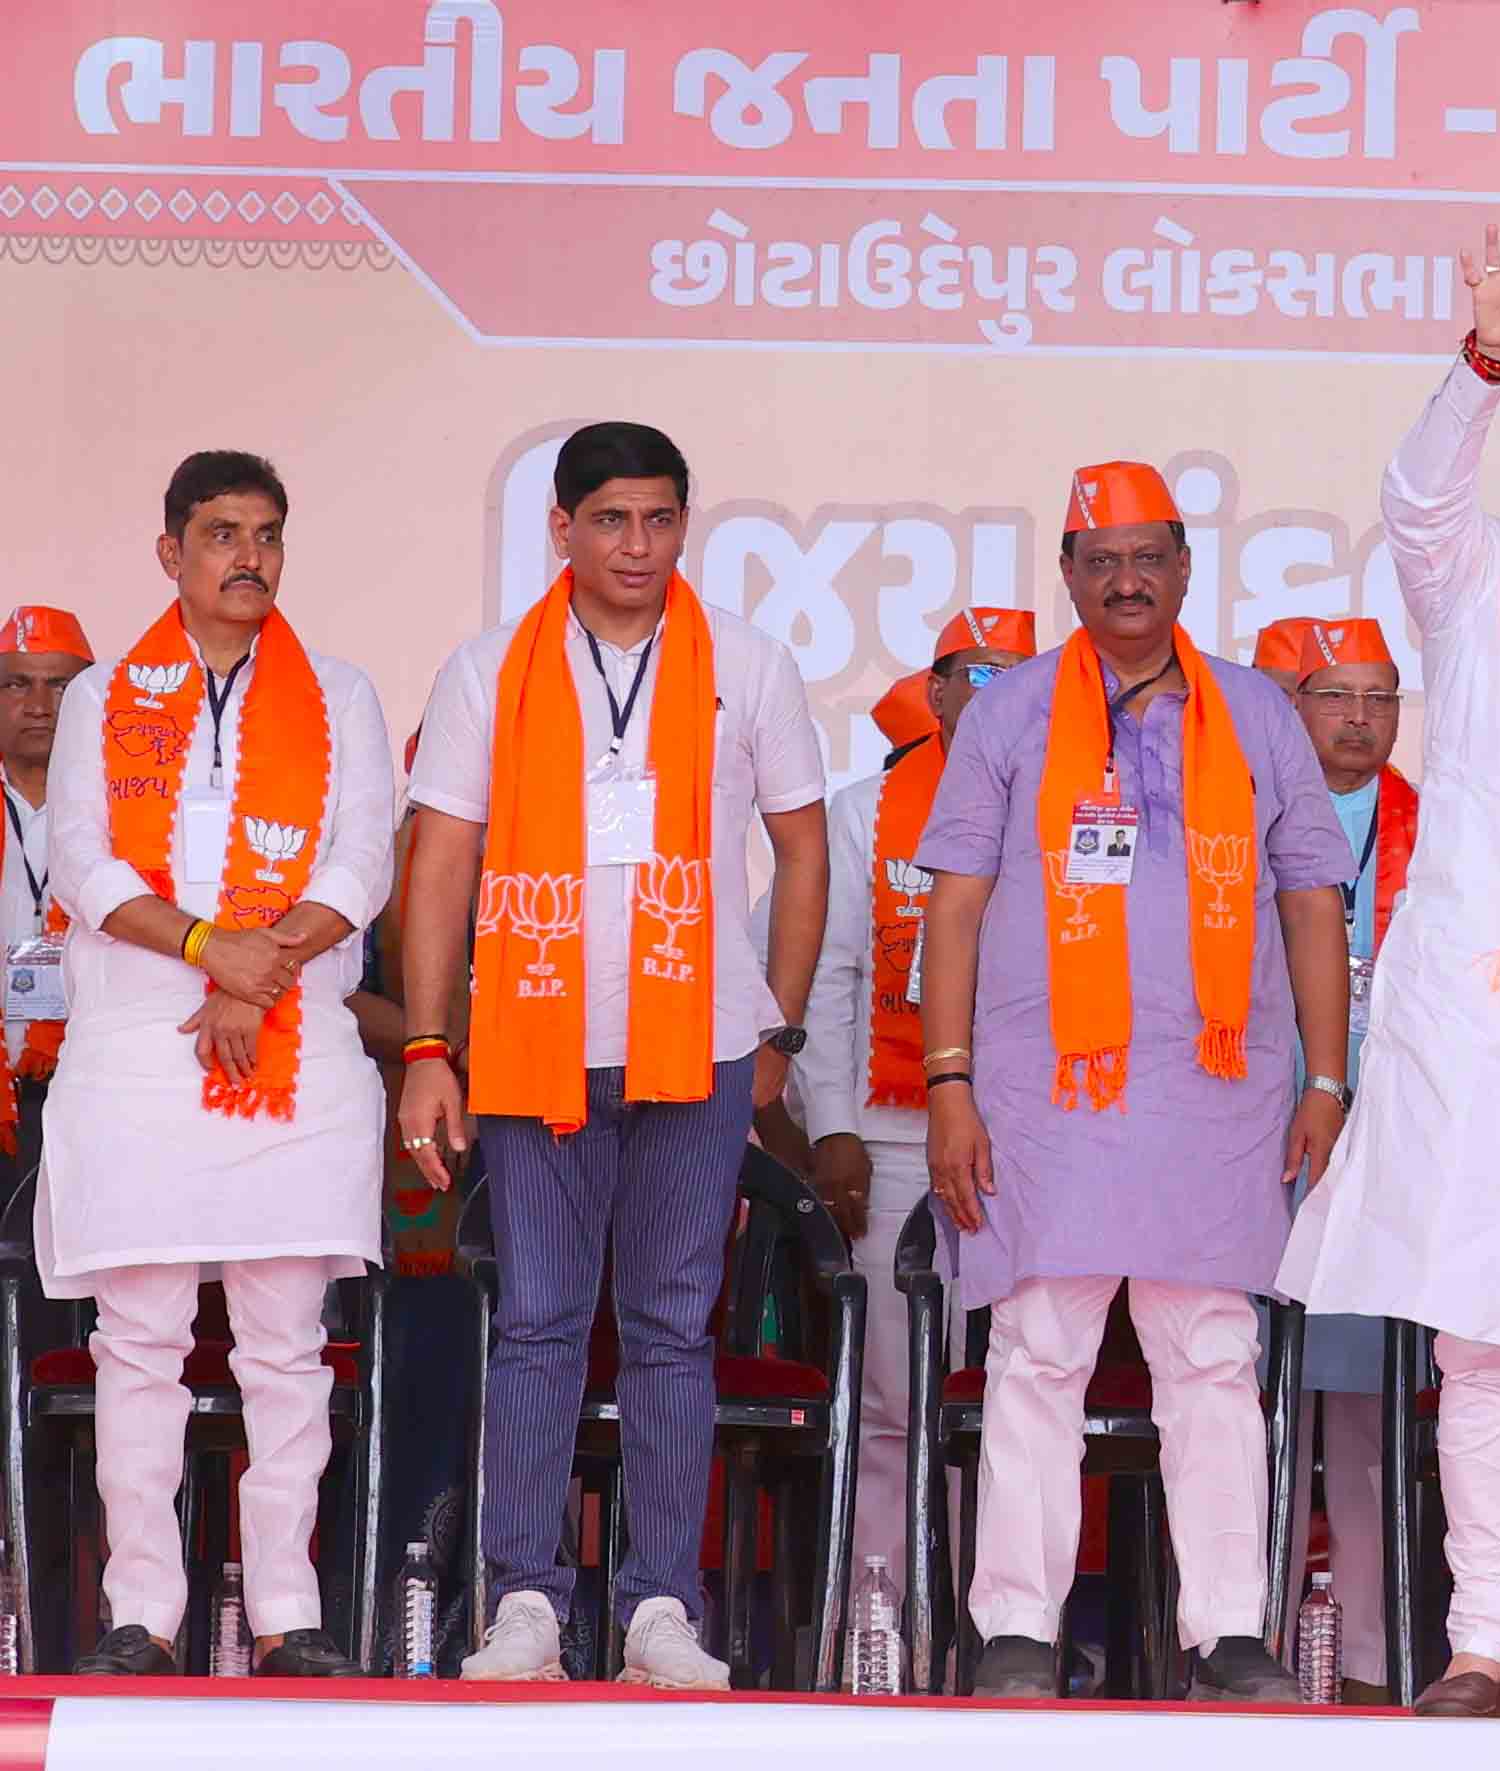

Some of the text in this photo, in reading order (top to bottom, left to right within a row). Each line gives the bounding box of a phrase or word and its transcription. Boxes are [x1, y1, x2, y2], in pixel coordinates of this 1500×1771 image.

[74, 0, 627, 145] ભારતીય
[674, 49, 1056, 152] જનતા
[1100, 7, 1422, 160] પાર્ટી
[1445, 108, 1497, 133] -
[650, 209, 1453, 346] છોટાઉદેપુર લોકસભા
